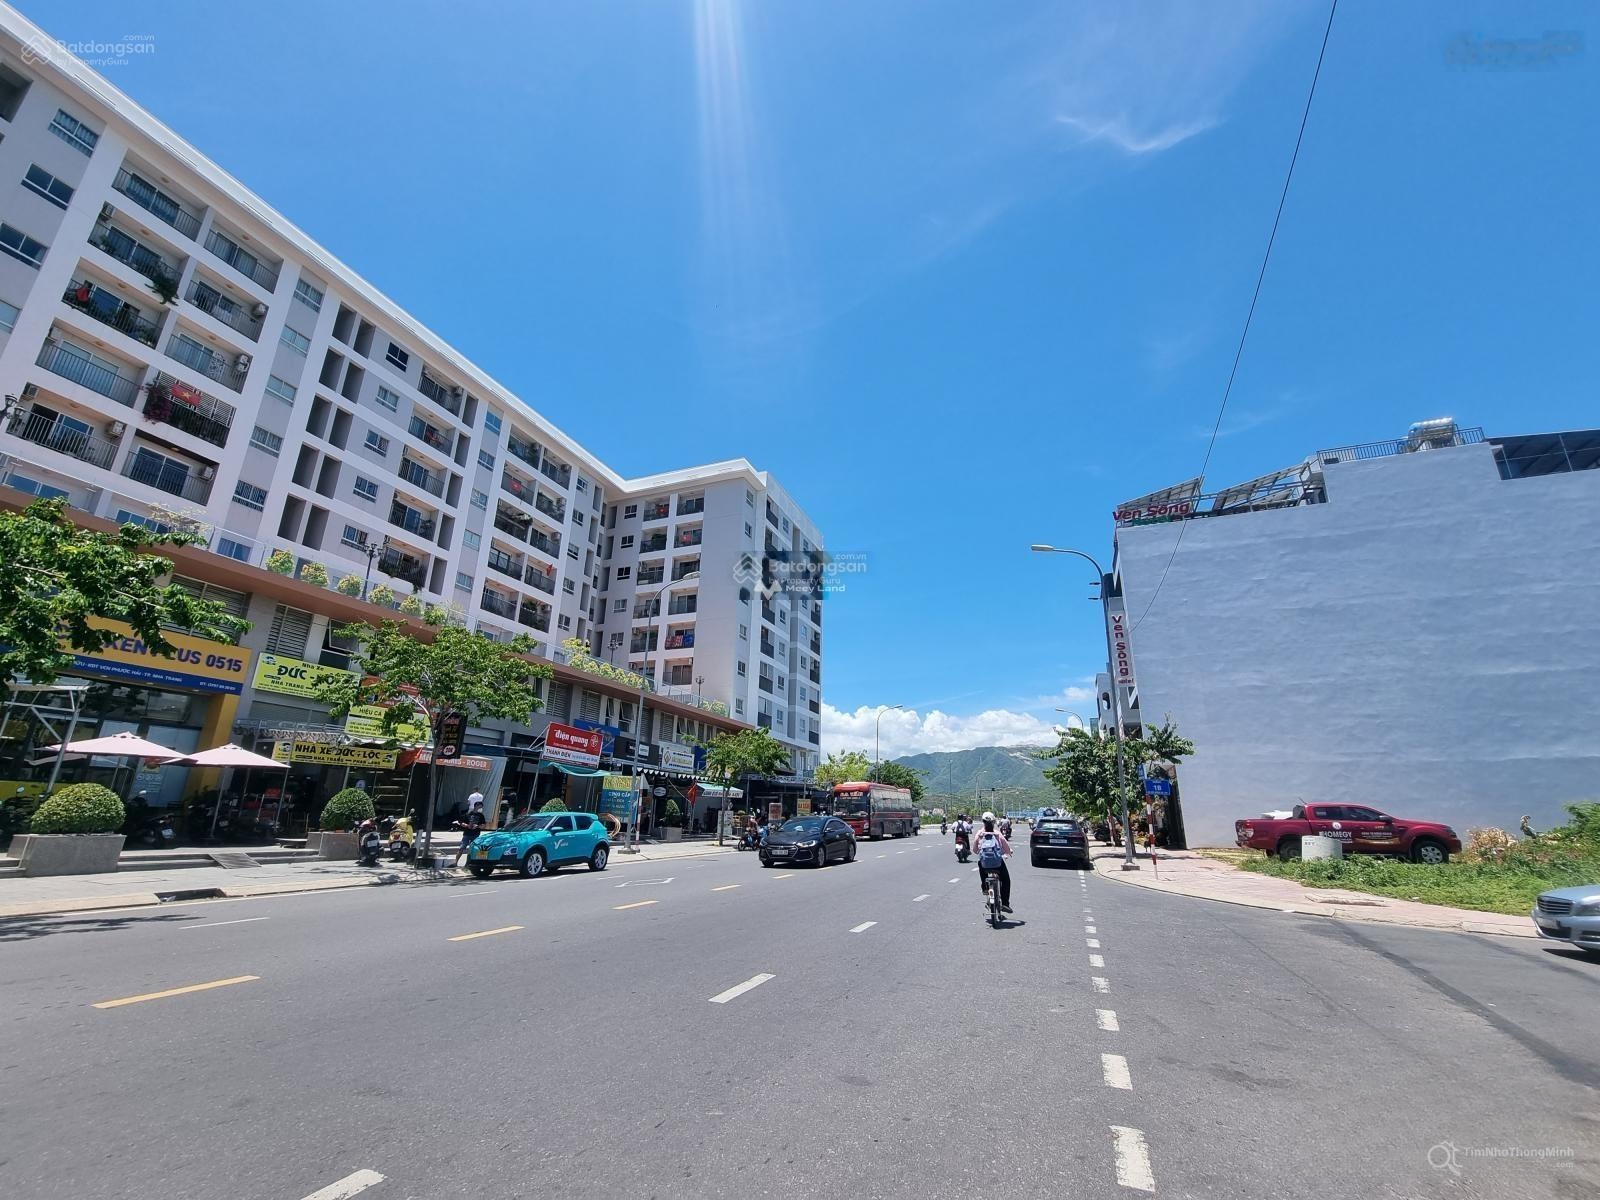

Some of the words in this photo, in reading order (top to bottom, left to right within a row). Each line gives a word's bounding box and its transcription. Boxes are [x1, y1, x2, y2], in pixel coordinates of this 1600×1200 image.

[1112, 509, 1142, 521] Ven
[1111, 615, 1124, 639] Ven
[205, 653, 243, 673] 0515
[1115, 641, 1129, 677] Sông
[277, 664, 308, 681] ĐỨC
[320, 746, 332, 755] XE
[362, 749, 381, 760] LỘC
